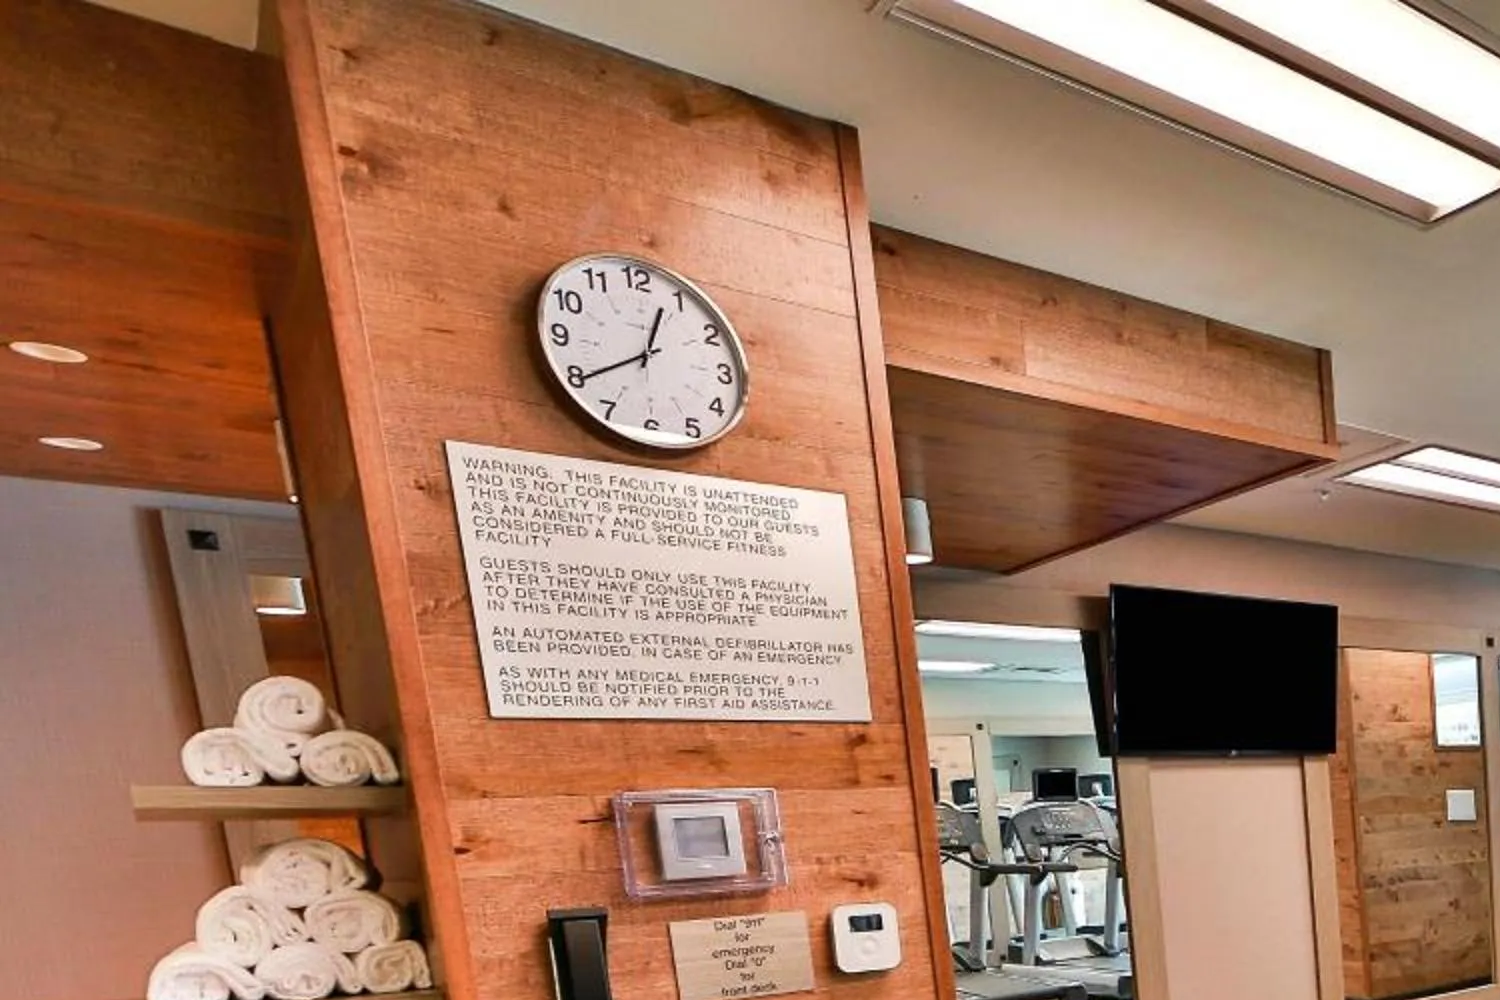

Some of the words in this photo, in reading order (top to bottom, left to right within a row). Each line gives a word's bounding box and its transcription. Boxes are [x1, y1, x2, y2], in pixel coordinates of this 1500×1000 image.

[582, 268, 607, 293] 11
[622, 266, 651, 293] 12
[554, 288, 583, 314] 10
[673, 291, 683, 312] 1
[551, 323, 569, 347] 9
[704, 324, 720, 347] 2
[567, 365, 585, 388] 8
[717, 363, 733, 385] 3
[600, 399, 616, 420] 7
[709, 397, 725, 417] 4
[685, 417, 702, 438] 5
[466, 472, 503, 487] AND
[510, 477, 527, 489] IS
[533, 481, 568, 494] NOT
[575, 485, 698, 509] CONTINUOUSLY
[705, 501, 791, 521] MONITORED
[565, 469, 603, 485] THIS
[609, 475, 677, 493] FACILITY
[683, 485, 697, 497] IS
[703, 488, 798, 509] UNATTENDED
[467, 485, 509, 502] THIS
[515, 491, 589, 510] FACILITY
[597, 501, 612, 513] IS
[618, 503, 697, 523] PROVIDED
[704, 513, 722, 526] TO
[728, 516, 759, 529] OUR
[764, 520, 819, 537] GUESTS
[471, 501, 493, 515] AS
[501, 504, 525, 517] AN
[532, 508, 605, 525] AMENITY
[613, 517, 646, 531] AND
[652, 520, 715, 536] SHOULD
[720, 528, 748, 540] NOT
[755, 532, 772, 543] BE
[473, 515, 588, 537] CONSIDERED
[727, 542, 787, 557] FITNESS
[479, 555, 551, 573] GUESTS
[558, 563, 625, 579] SHOULD
[631, 569, 671, 582] ONLY
[678, 573, 708, 587] USE
[714, 575, 746, 589] THIS
[751, 579, 811, 594] FACILITY
[482, 571, 539, 586] AFTER
[545, 575, 590, 589] THEY
[597, 581, 639, 594] HAVE
[645, 583, 734, 600] CONSULTED
[485, 585, 508, 599] TO
[515, 587, 613, 605] DETERMINE
[620, 595, 633, 606] IF
[640, 595, 671, 609] THE
[677, 600, 706, 612] USE
[711, 601, 733, 613] OF
[738, 603, 764, 615] THE
[770, 605, 848, 620] EQUIPMENT
[487, 600, 505, 612] IN
[512, 601, 551, 614] THIS
[557, 604, 627, 619] FACILITY
[635, 610, 649, 621] IS
[492, 625, 515, 637] AN
[523, 627, 624, 643] AUTOMATED
[630, 633, 708, 646] EXTERNAL
[715, 637, 822, 653] DEFIBRILLATOR
[828, 643, 854, 654] HAS
[493, 639, 541, 653] BEEN
[642, 647, 657, 658] IN
[663, 648, 703, 660] CASE
[708, 649, 728, 661] OF
[733, 651, 752, 662] AN
[499, 666, 521, 679] AS
[527, 667, 571, 679] WITH
[577, 669, 609, 681] ANY
[615, 669, 684, 683] MEDICAL
[501, 679, 571, 693] SHOULD
[578, 681, 599, 693] BE
[605, 682, 677, 695] NOTIFIED
[683, 685, 729, 697] PRIOR
[735, 686, 752, 698] TO
[760, 687, 785, 698] THE
[502, 693, 603, 707] RENDERING
[609, 696, 630, 707] OF
[637, 697, 668, 708] ANY
[675, 698, 715, 709] FIRST
[721, 699, 745, 709] AID
[711, 944, 775, 959] emergency
